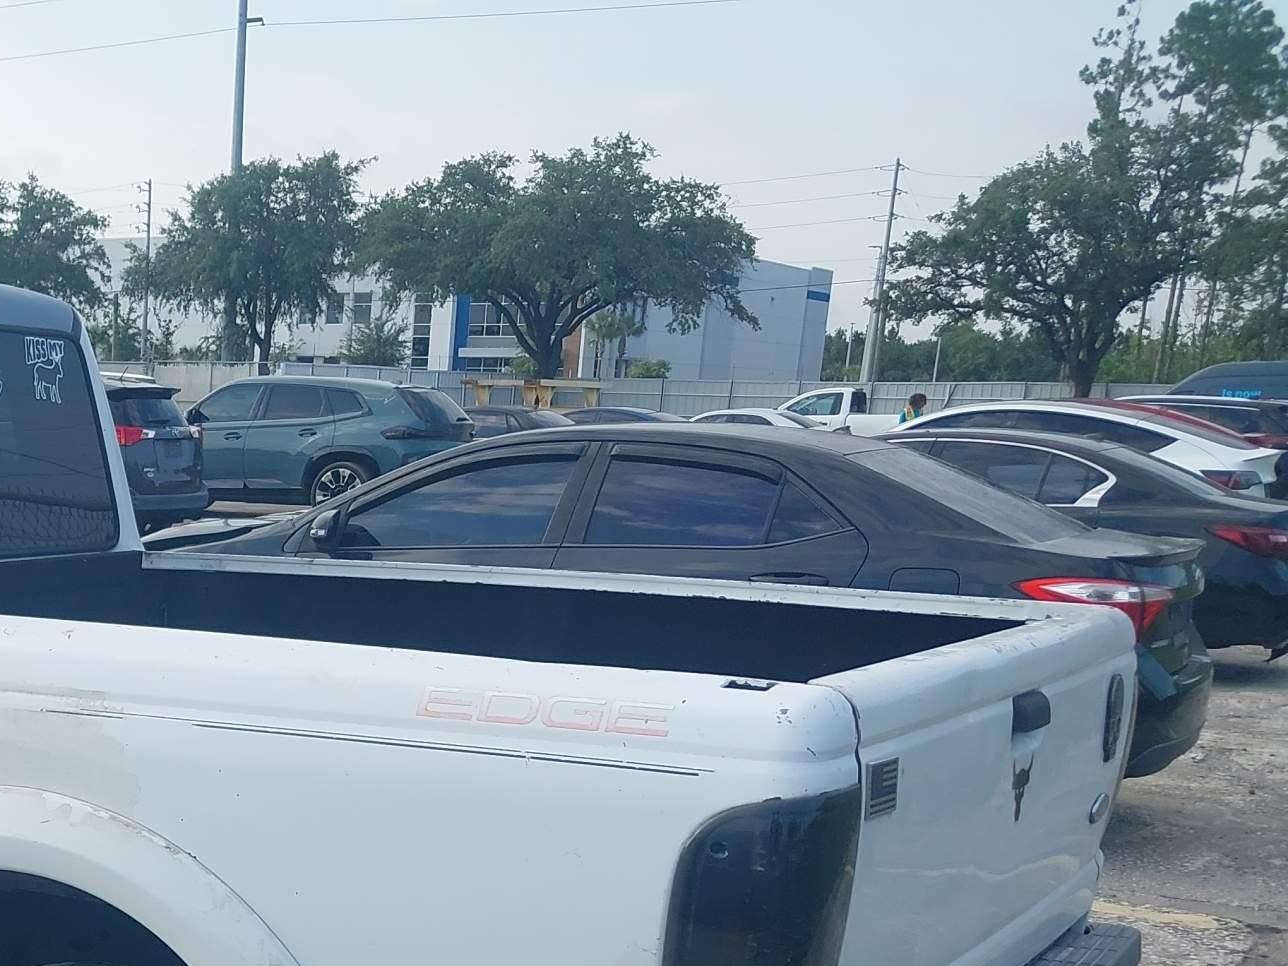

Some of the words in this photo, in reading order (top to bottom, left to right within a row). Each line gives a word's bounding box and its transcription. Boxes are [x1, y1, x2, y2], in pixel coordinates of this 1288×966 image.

[24, 336, 48, 364] KISS
[47, 339, 64, 359] MY
[415, 686, 676, 738] EDGE
